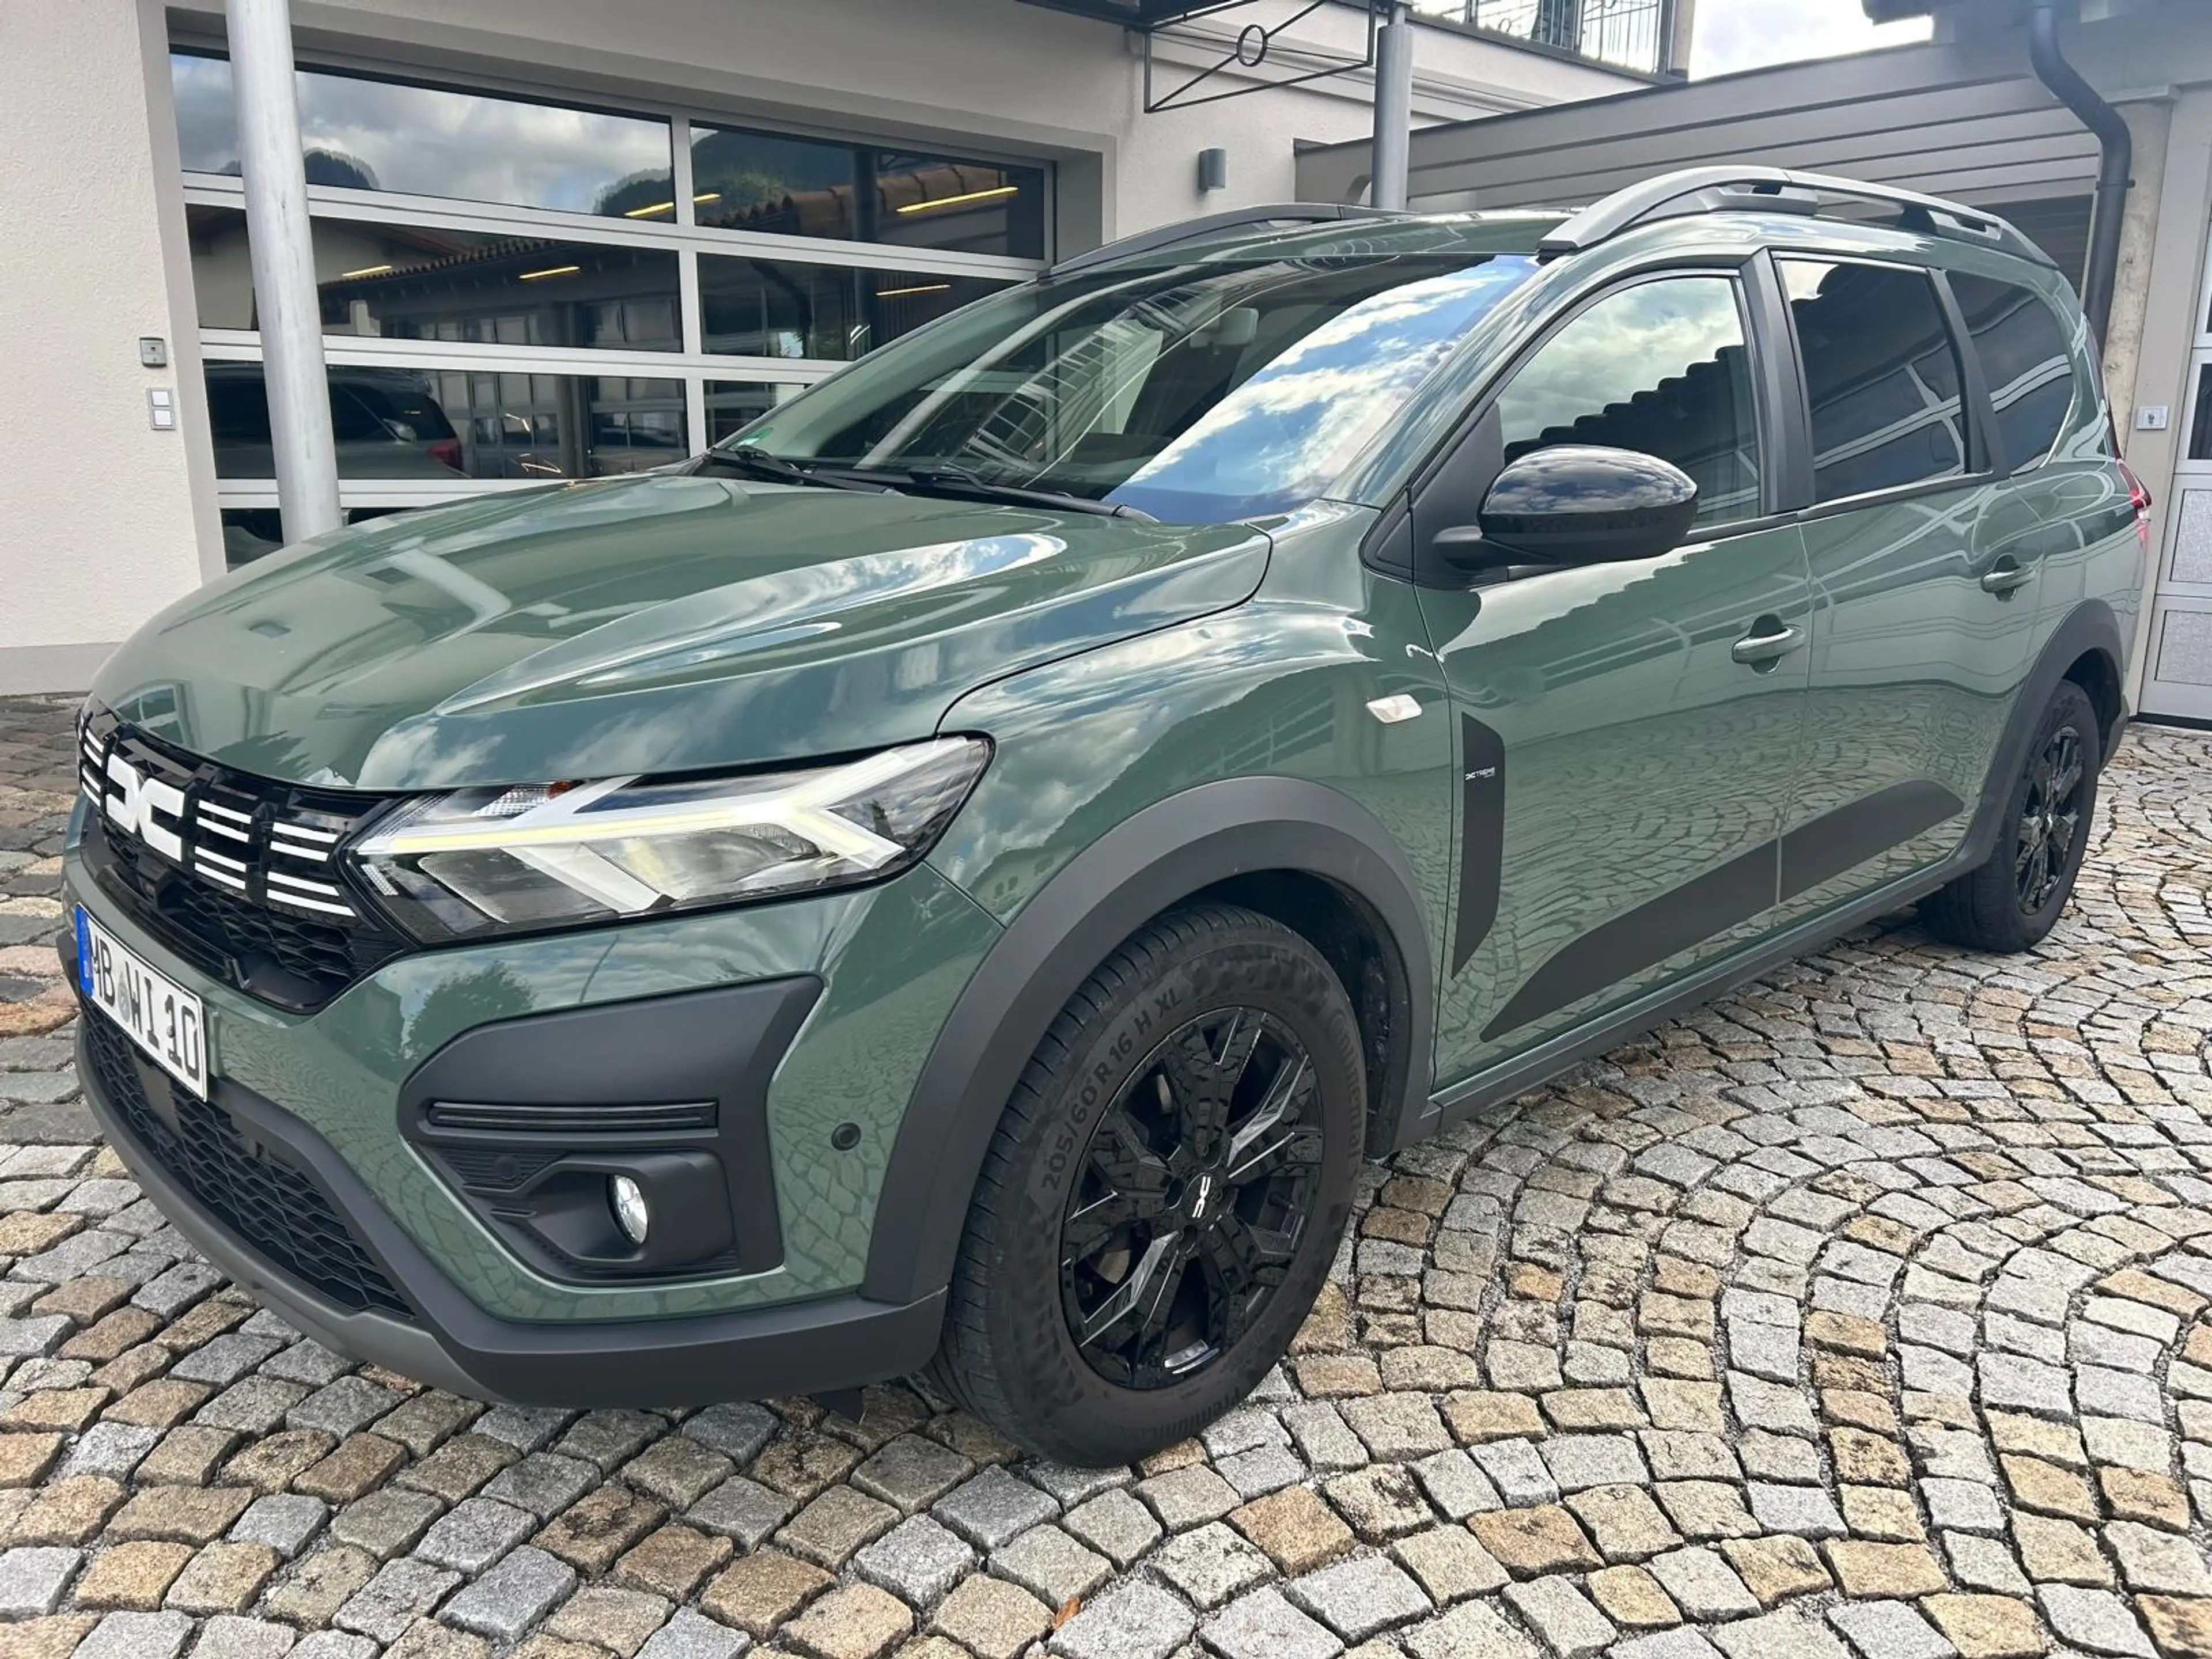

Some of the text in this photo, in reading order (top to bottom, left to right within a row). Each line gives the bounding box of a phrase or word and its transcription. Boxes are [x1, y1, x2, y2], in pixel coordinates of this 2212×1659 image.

[125, 960, 160, 1050] WI
[165, 993, 200, 1081] 10
[1040, 987, 1183, 1191] 205/60 R 16 H XL
